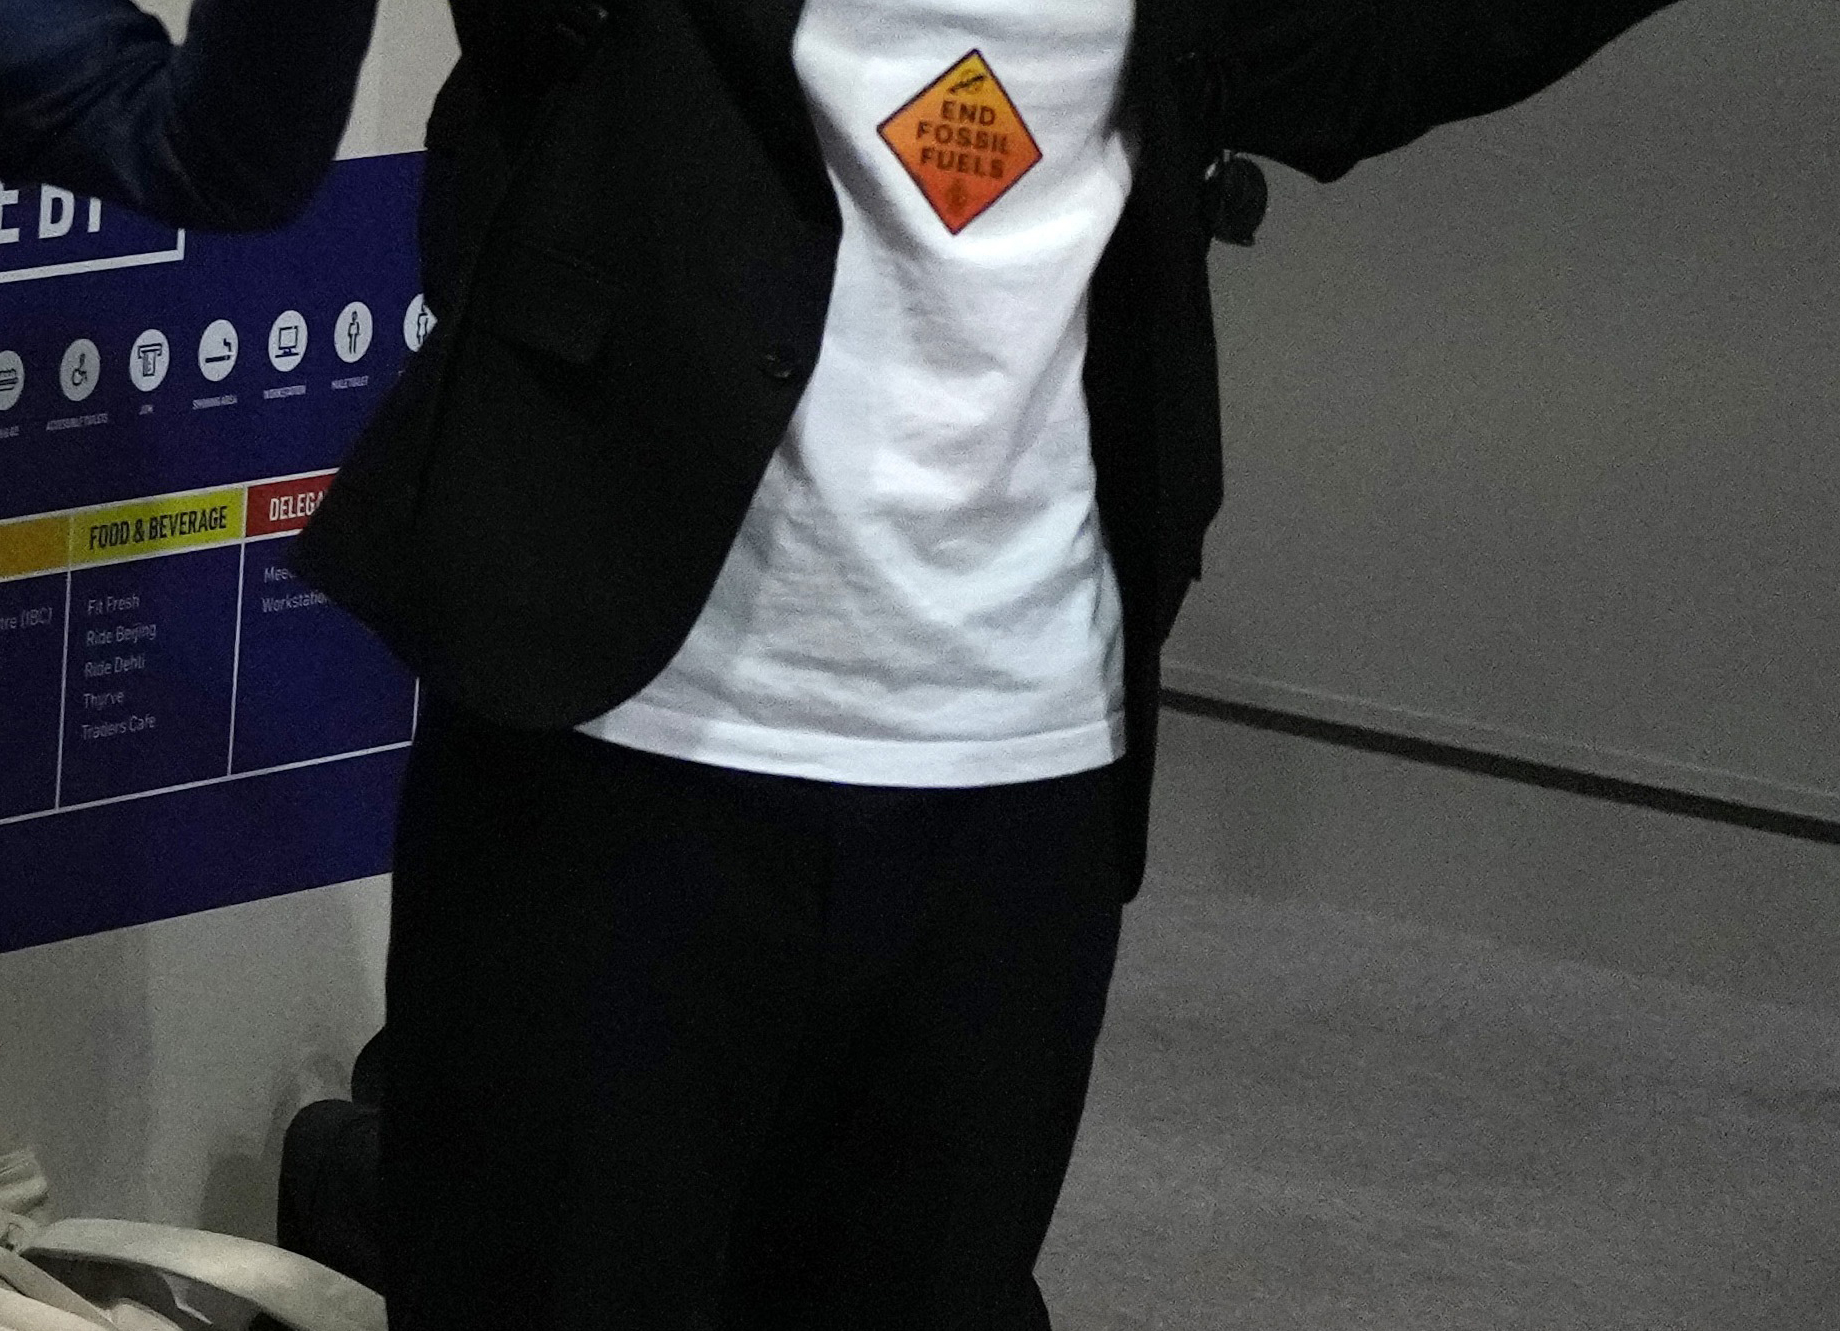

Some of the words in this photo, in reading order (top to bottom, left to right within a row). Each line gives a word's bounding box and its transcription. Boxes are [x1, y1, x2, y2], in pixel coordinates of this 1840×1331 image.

[941, 100, 997, 127] END
[916, 121, 1009, 155] FOSSIL
[920, 146, 1004, 179] FUELS
[269, 491, 326, 522] DELEGA
[89, 520, 129, 550] FOOD
[133, 518, 145, 544] &
[148, 505, 228, 541] BEVERAGE
